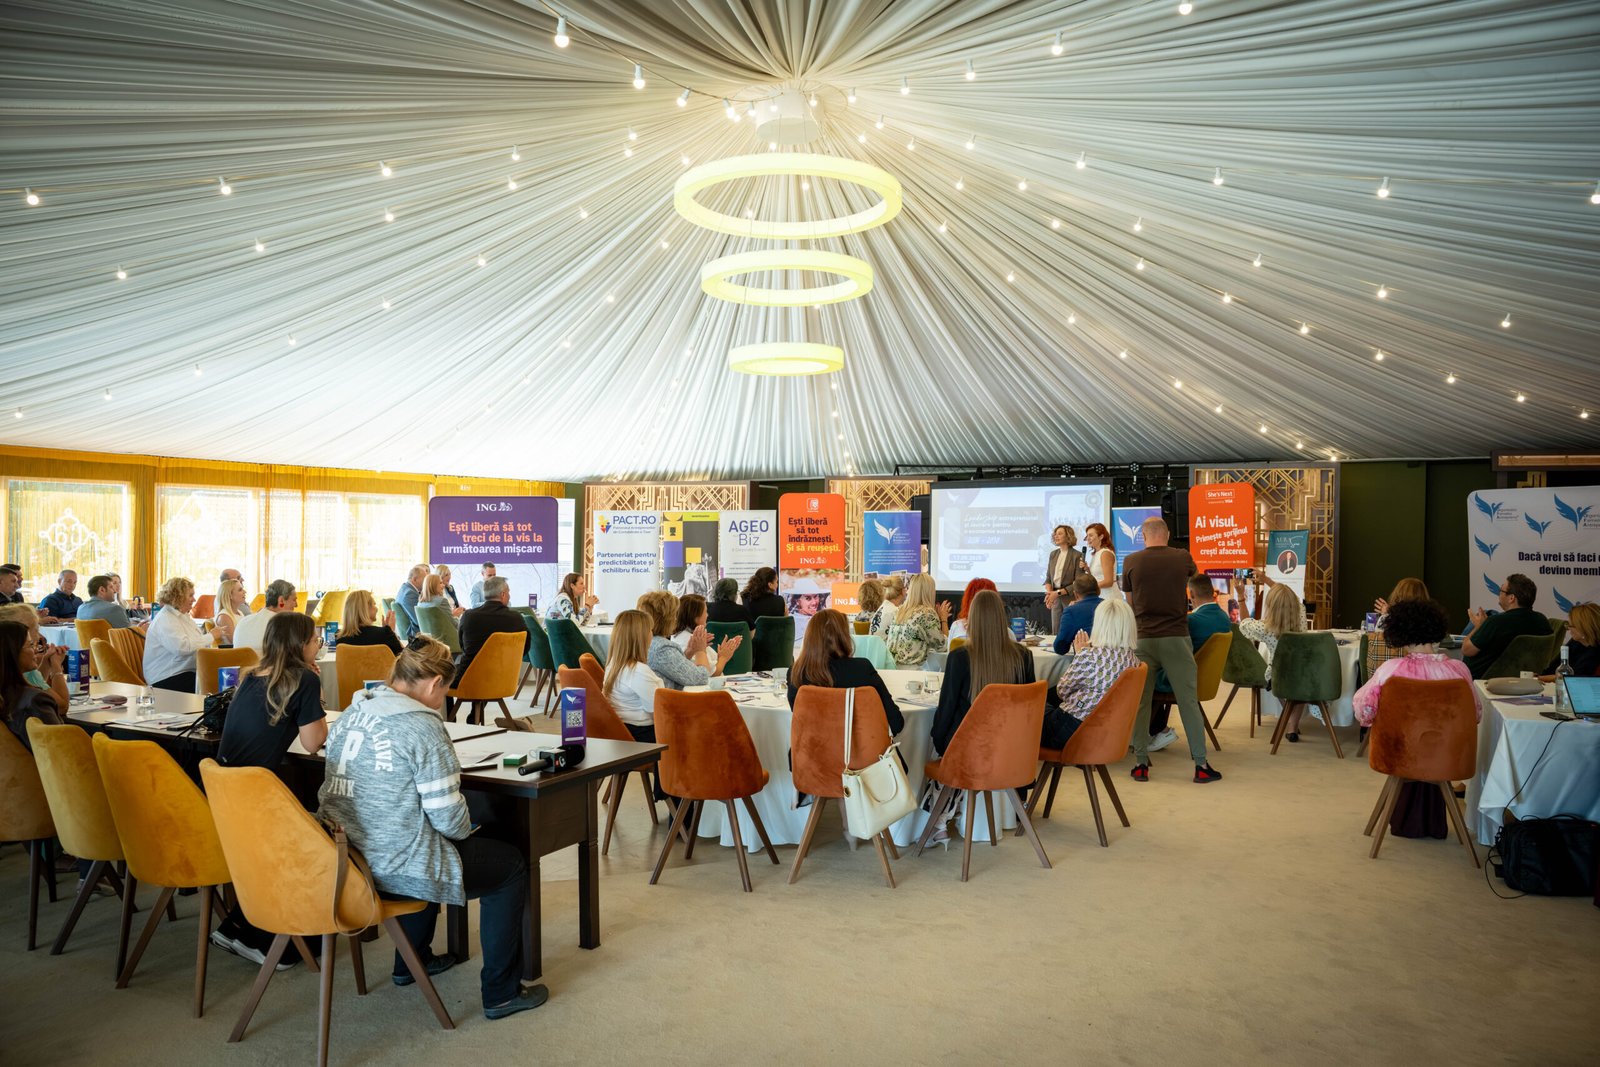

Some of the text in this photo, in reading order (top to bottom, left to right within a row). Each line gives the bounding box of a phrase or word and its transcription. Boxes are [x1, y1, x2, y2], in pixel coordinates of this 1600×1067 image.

[613, 516, 656, 524] PACT.RO
[788, 518, 803, 527] Ești
[1195, 515, 1237, 528] Ai visul.
[449, 522, 532, 534] Ești liberă să tot
[729, 520, 769, 532] AGEO
[462, 533, 542, 542] treci de la vis la
[739, 533, 759, 546] Biz
[788, 535, 833, 544] îndrăznești.
[1195, 526, 1248, 543] Primește sprijinul
[796, 544, 805, 552] să
[808, 544, 840, 554] reușești.
[1227, 539, 1241, 548] să-ți
[443, 543, 542, 556] următoarea mișcare
[1200, 548, 1217, 557] crești
[1518, 551, 1541, 562] Dacă
[1543, 552, 1561, 562] vrei
[1564, 552, 1575, 562] să
[1577, 552, 1596, 562] faci
[1539, 565, 1600, 576] devino mem
[346, 712, 393, 772] PINK LOVE
[337, 730, 364, 774] P
